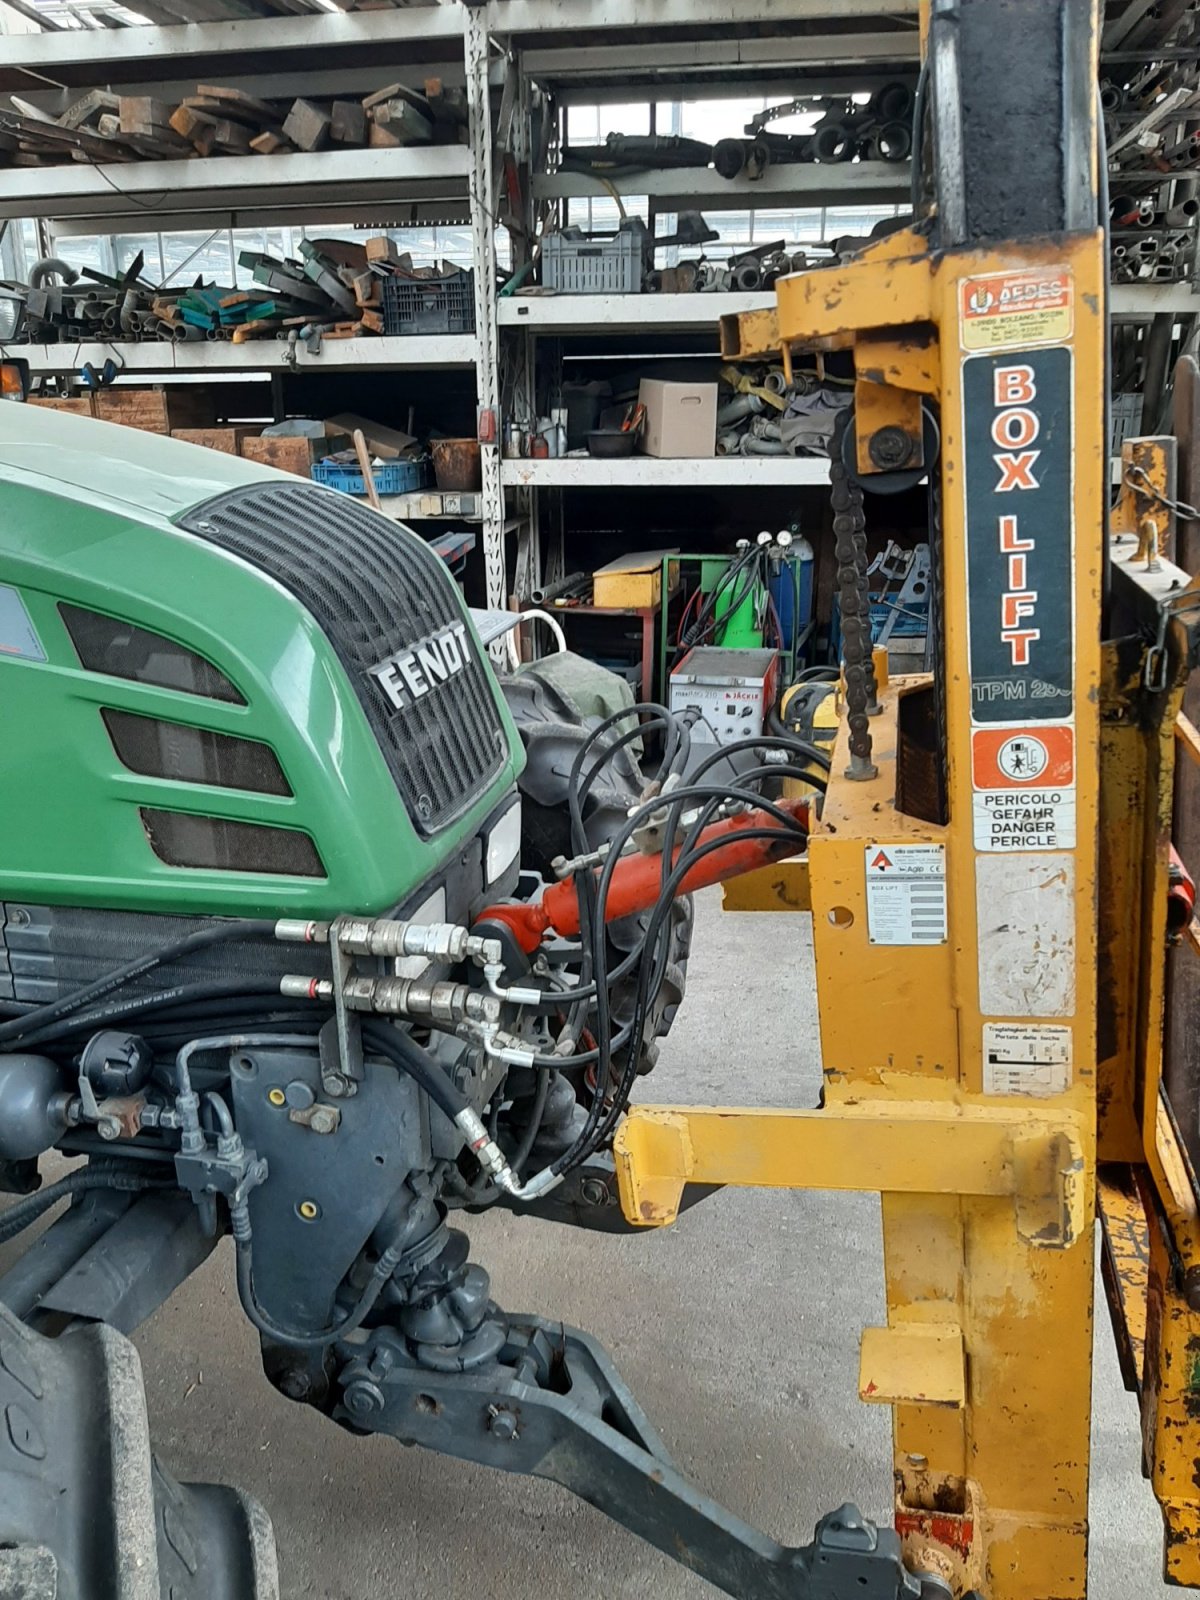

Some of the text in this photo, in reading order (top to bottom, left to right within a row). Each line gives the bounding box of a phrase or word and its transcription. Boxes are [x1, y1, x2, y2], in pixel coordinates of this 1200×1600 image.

[991, 364, 1041, 492] BOX
[1000, 515, 1041, 665] LIFT
[376, 623, 471, 710] FENDT
[973, 680, 1026, 701] TPM
[985, 793, 1061, 806] PERICOLO
[992, 808, 1054, 820] GEFAHR
[992, 822, 1055, 834] DANGER
[991, 836, 1057, 847] PERICLE
